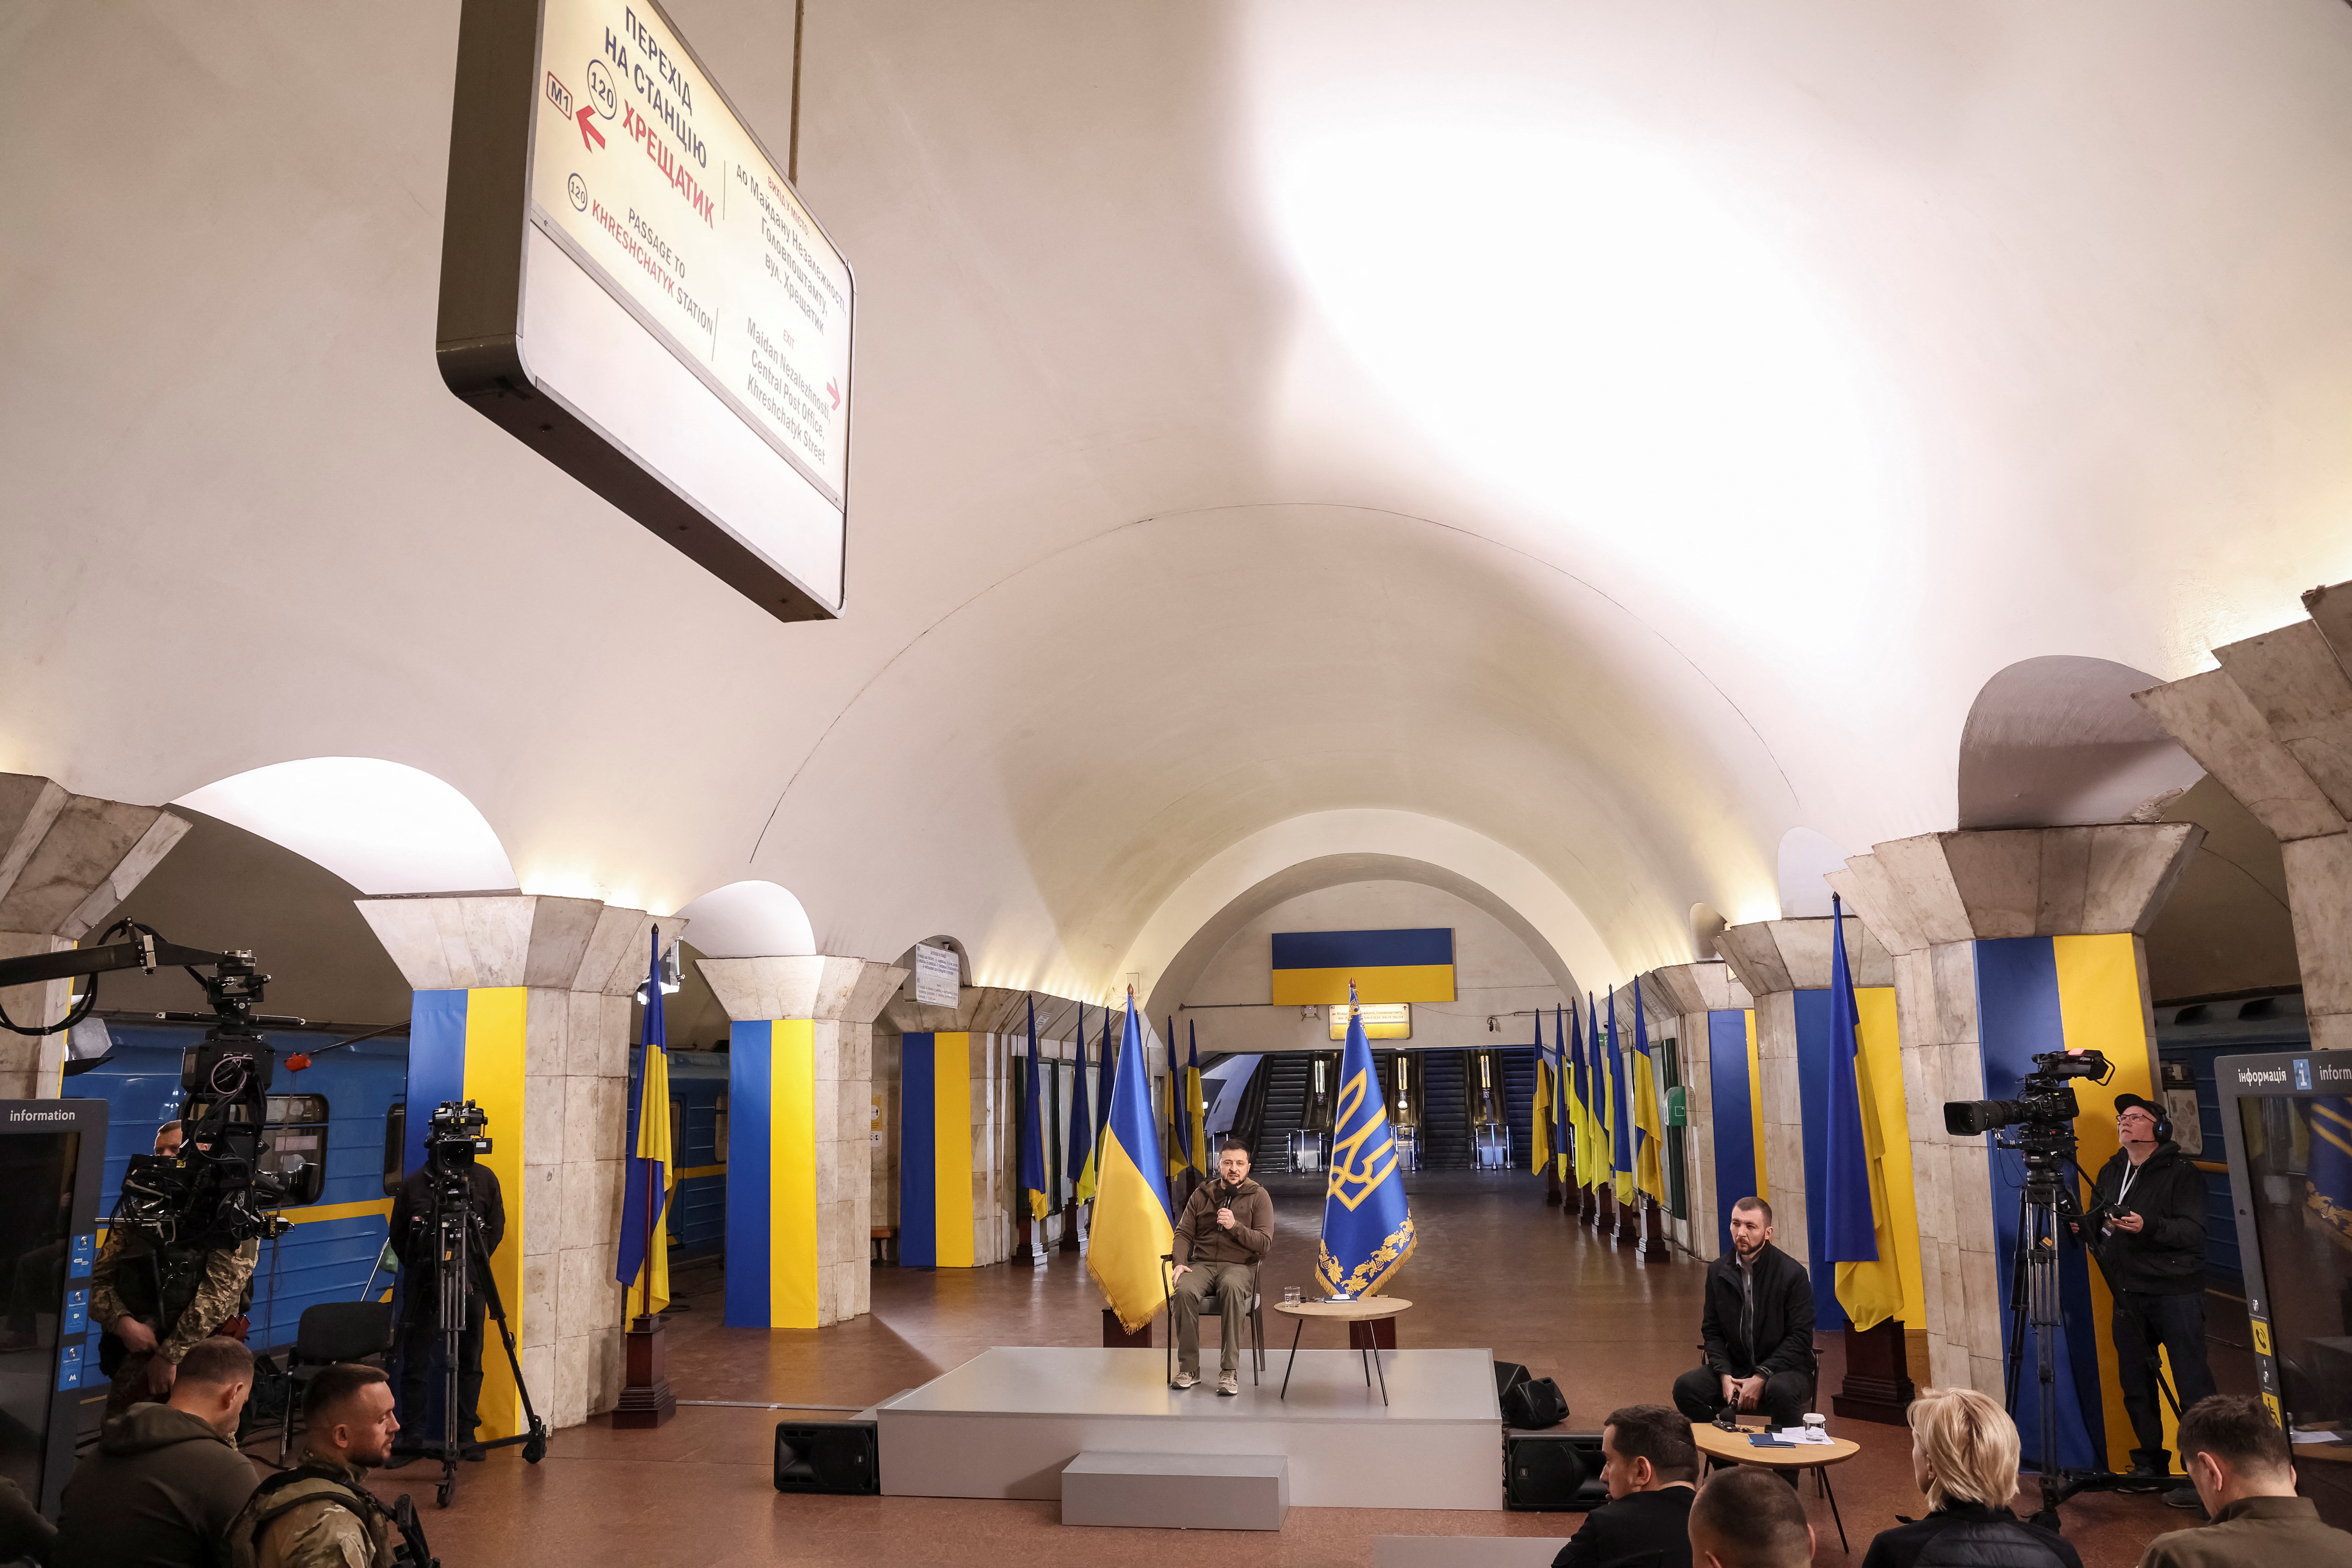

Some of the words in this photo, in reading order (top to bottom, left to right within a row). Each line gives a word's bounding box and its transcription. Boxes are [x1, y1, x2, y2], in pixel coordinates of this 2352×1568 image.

[605, 26, 628, 79] НА
[634, 64, 706, 168] СТАНЦІЮ
[626, 5, 692, 117] ПЕРЕХІД
[570, 181, 585, 204] 120
[591, 72, 613, 109] 120
[622, 98, 714, 230] ХРЕЩАТИК
[628, 207, 672, 266] PASSAGE
[674, 255, 685, 278] TO
[737, 163, 748, 186] до
[750, 175, 790, 243] Майдану
[792, 229, 846, 318] Незалежності,
[768, 175, 786, 210] ВИХІД
[786, 199, 789, 211] У
[791, 206, 809, 238] МІСТО:
[592, 198, 675, 298] KHRESHCHATYK
[677, 287, 713, 336] STATION
[762, 216, 828, 318] Головпоштамту,
[766, 253, 782, 284] вул.
[784, 271, 824, 336] Хрещатик
[747, 316, 778, 365] Maidan
[780, 353, 830, 425] Nezalezhnosti,
[783, 329, 794, 350] EXIT
[747, 374, 802, 442] Khreshchatyk
[803, 430, 825, 465] Street
[751, 349, 782, 394] Central
[784, 383, 800, 414] Post
[802, 403, 824, 443] Office,
[10, 1109, 75, 1122] information
[2238, 1067, 2287, 1087] інформація
[2319, 1064, 2352, 1081] inform
